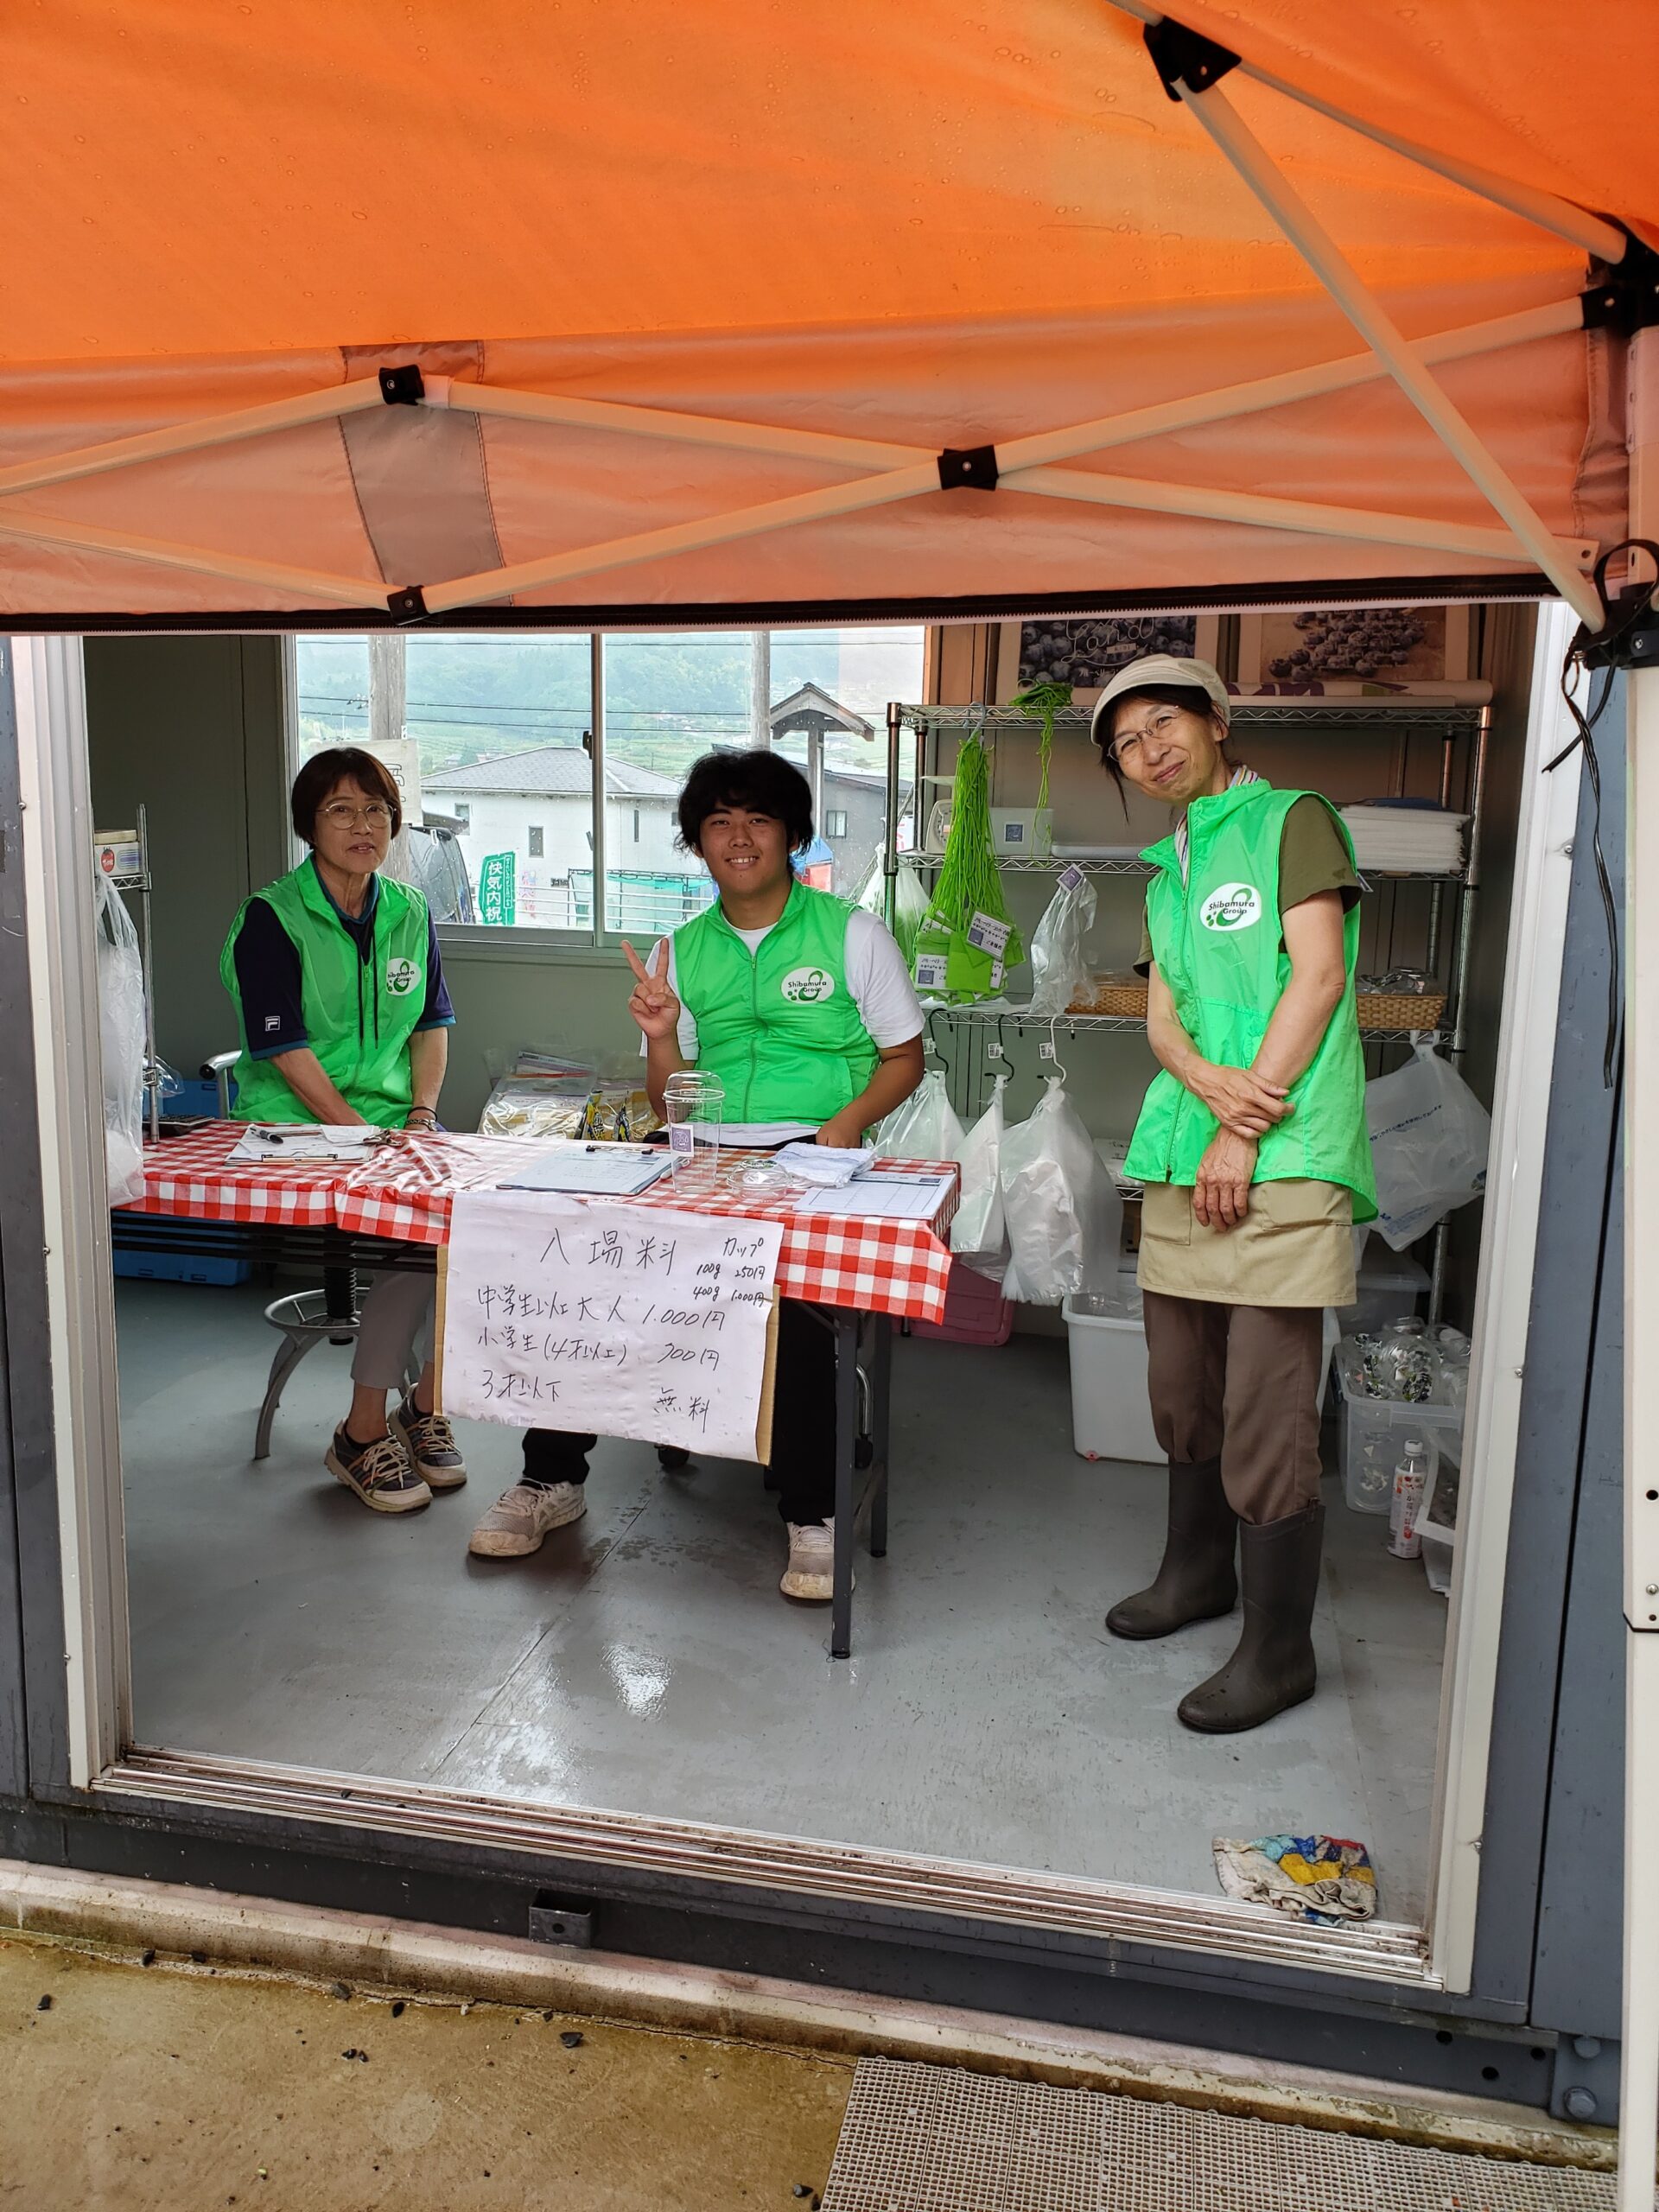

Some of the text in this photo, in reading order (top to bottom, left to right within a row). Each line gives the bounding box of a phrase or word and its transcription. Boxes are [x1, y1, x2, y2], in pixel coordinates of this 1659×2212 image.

[486, 861, 503, 923] 快気内祝
[1208, 899, 1255, 911] Shibamura
[540, 1227, 677, 1276] 入場料
[722, 1236, 765, 1258] カップ
[696, 1262, 766, 1281] 100g 250円
[692, 1286, 721, 1302] 400g
[481, 1369, 711, 1434] 3才以下 無料
